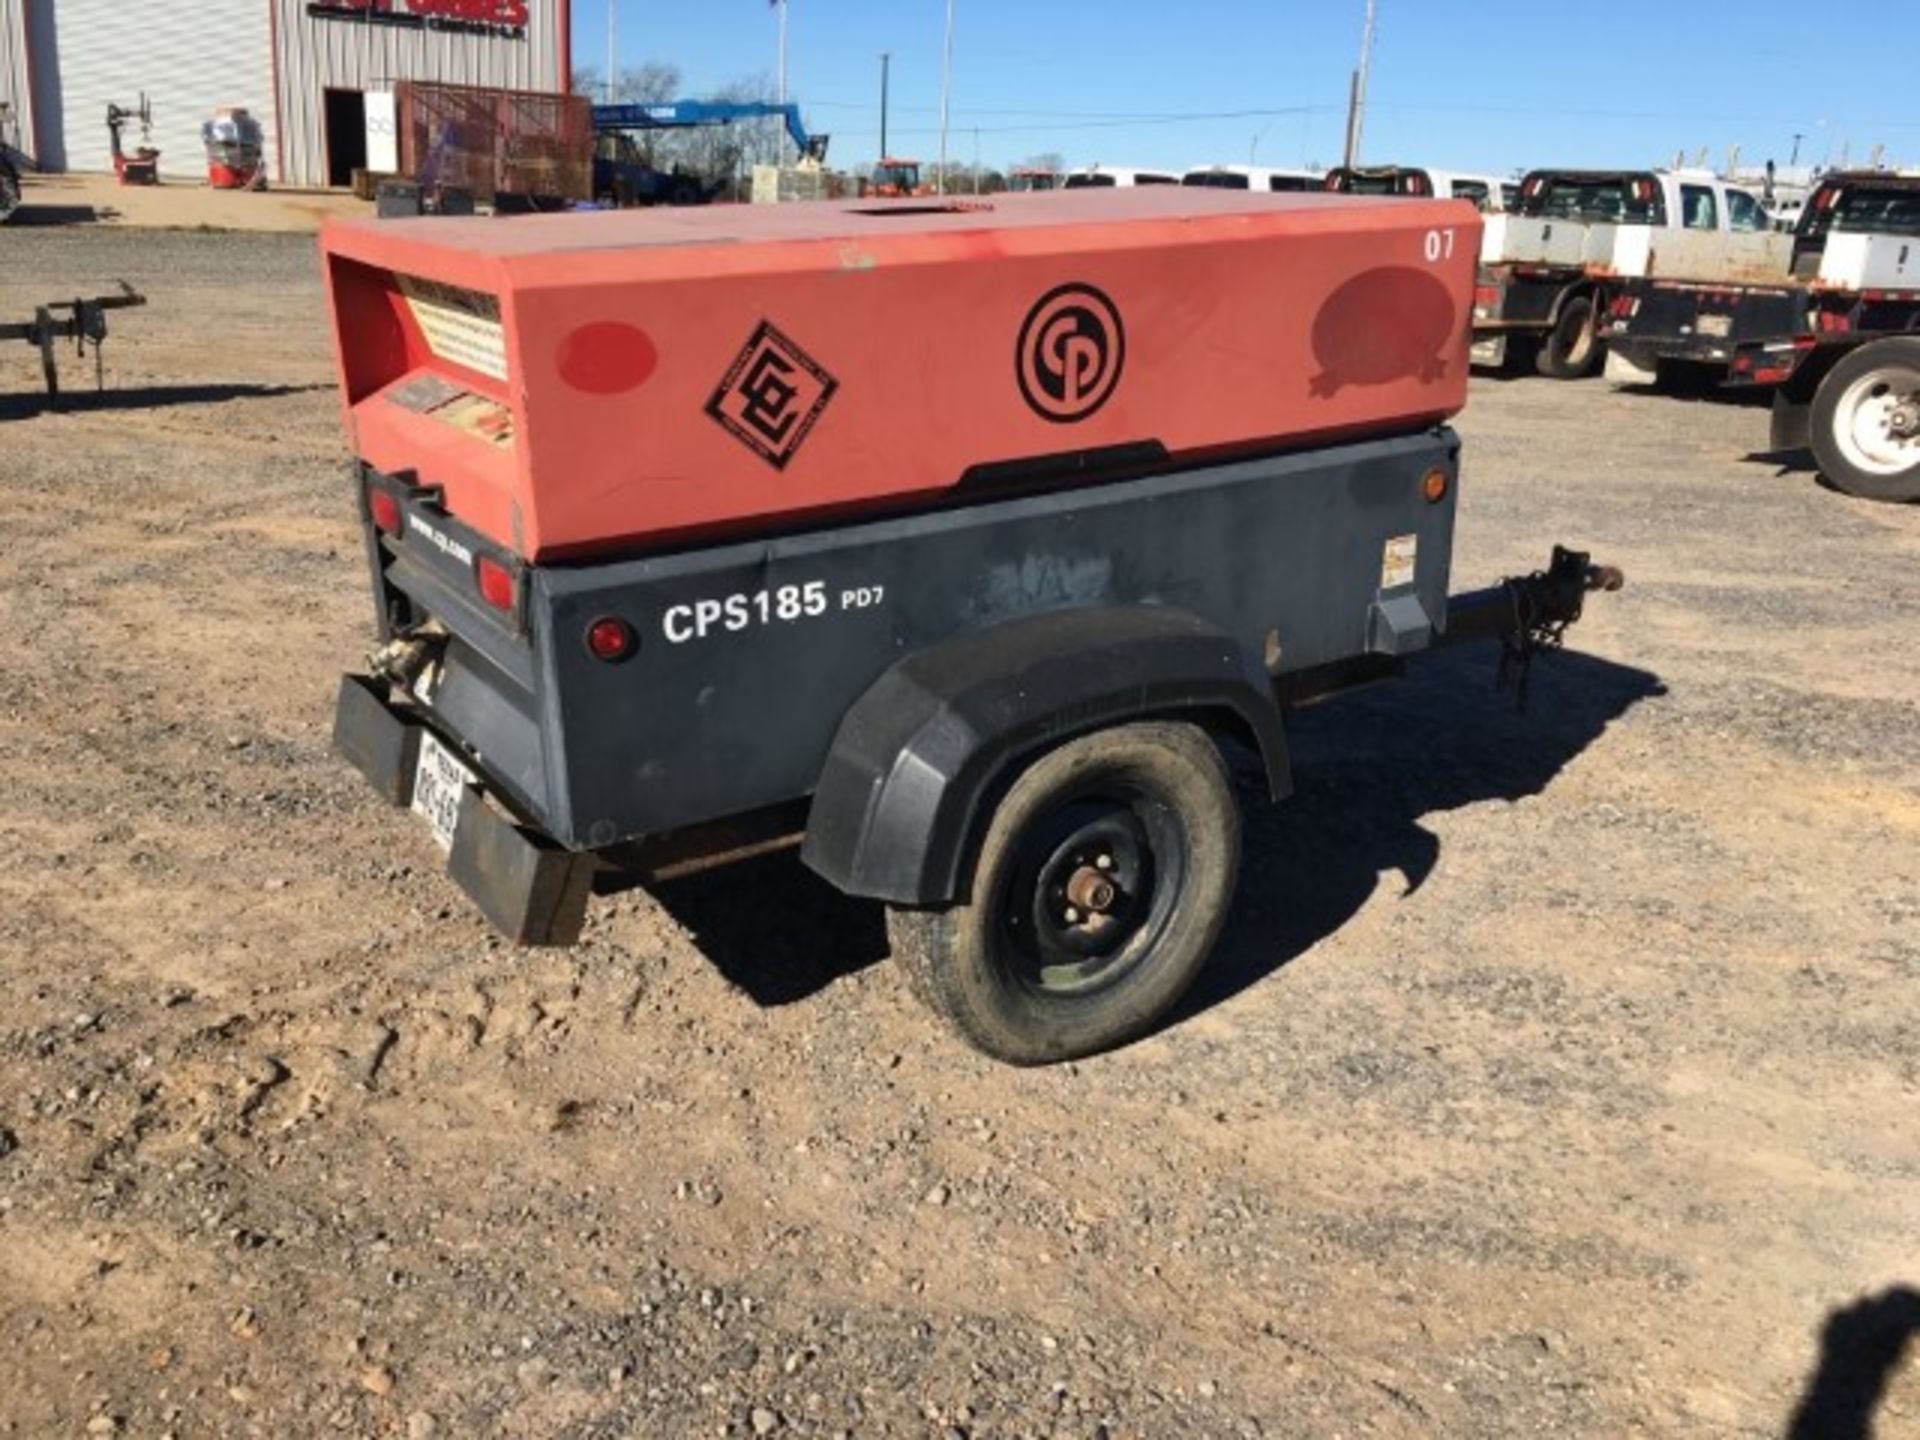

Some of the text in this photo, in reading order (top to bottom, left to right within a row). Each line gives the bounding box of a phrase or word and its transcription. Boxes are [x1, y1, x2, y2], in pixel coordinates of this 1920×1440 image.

[1425, 229, 1453, 261] 07
[662, 580, 884, 643] CPS185 PD7
